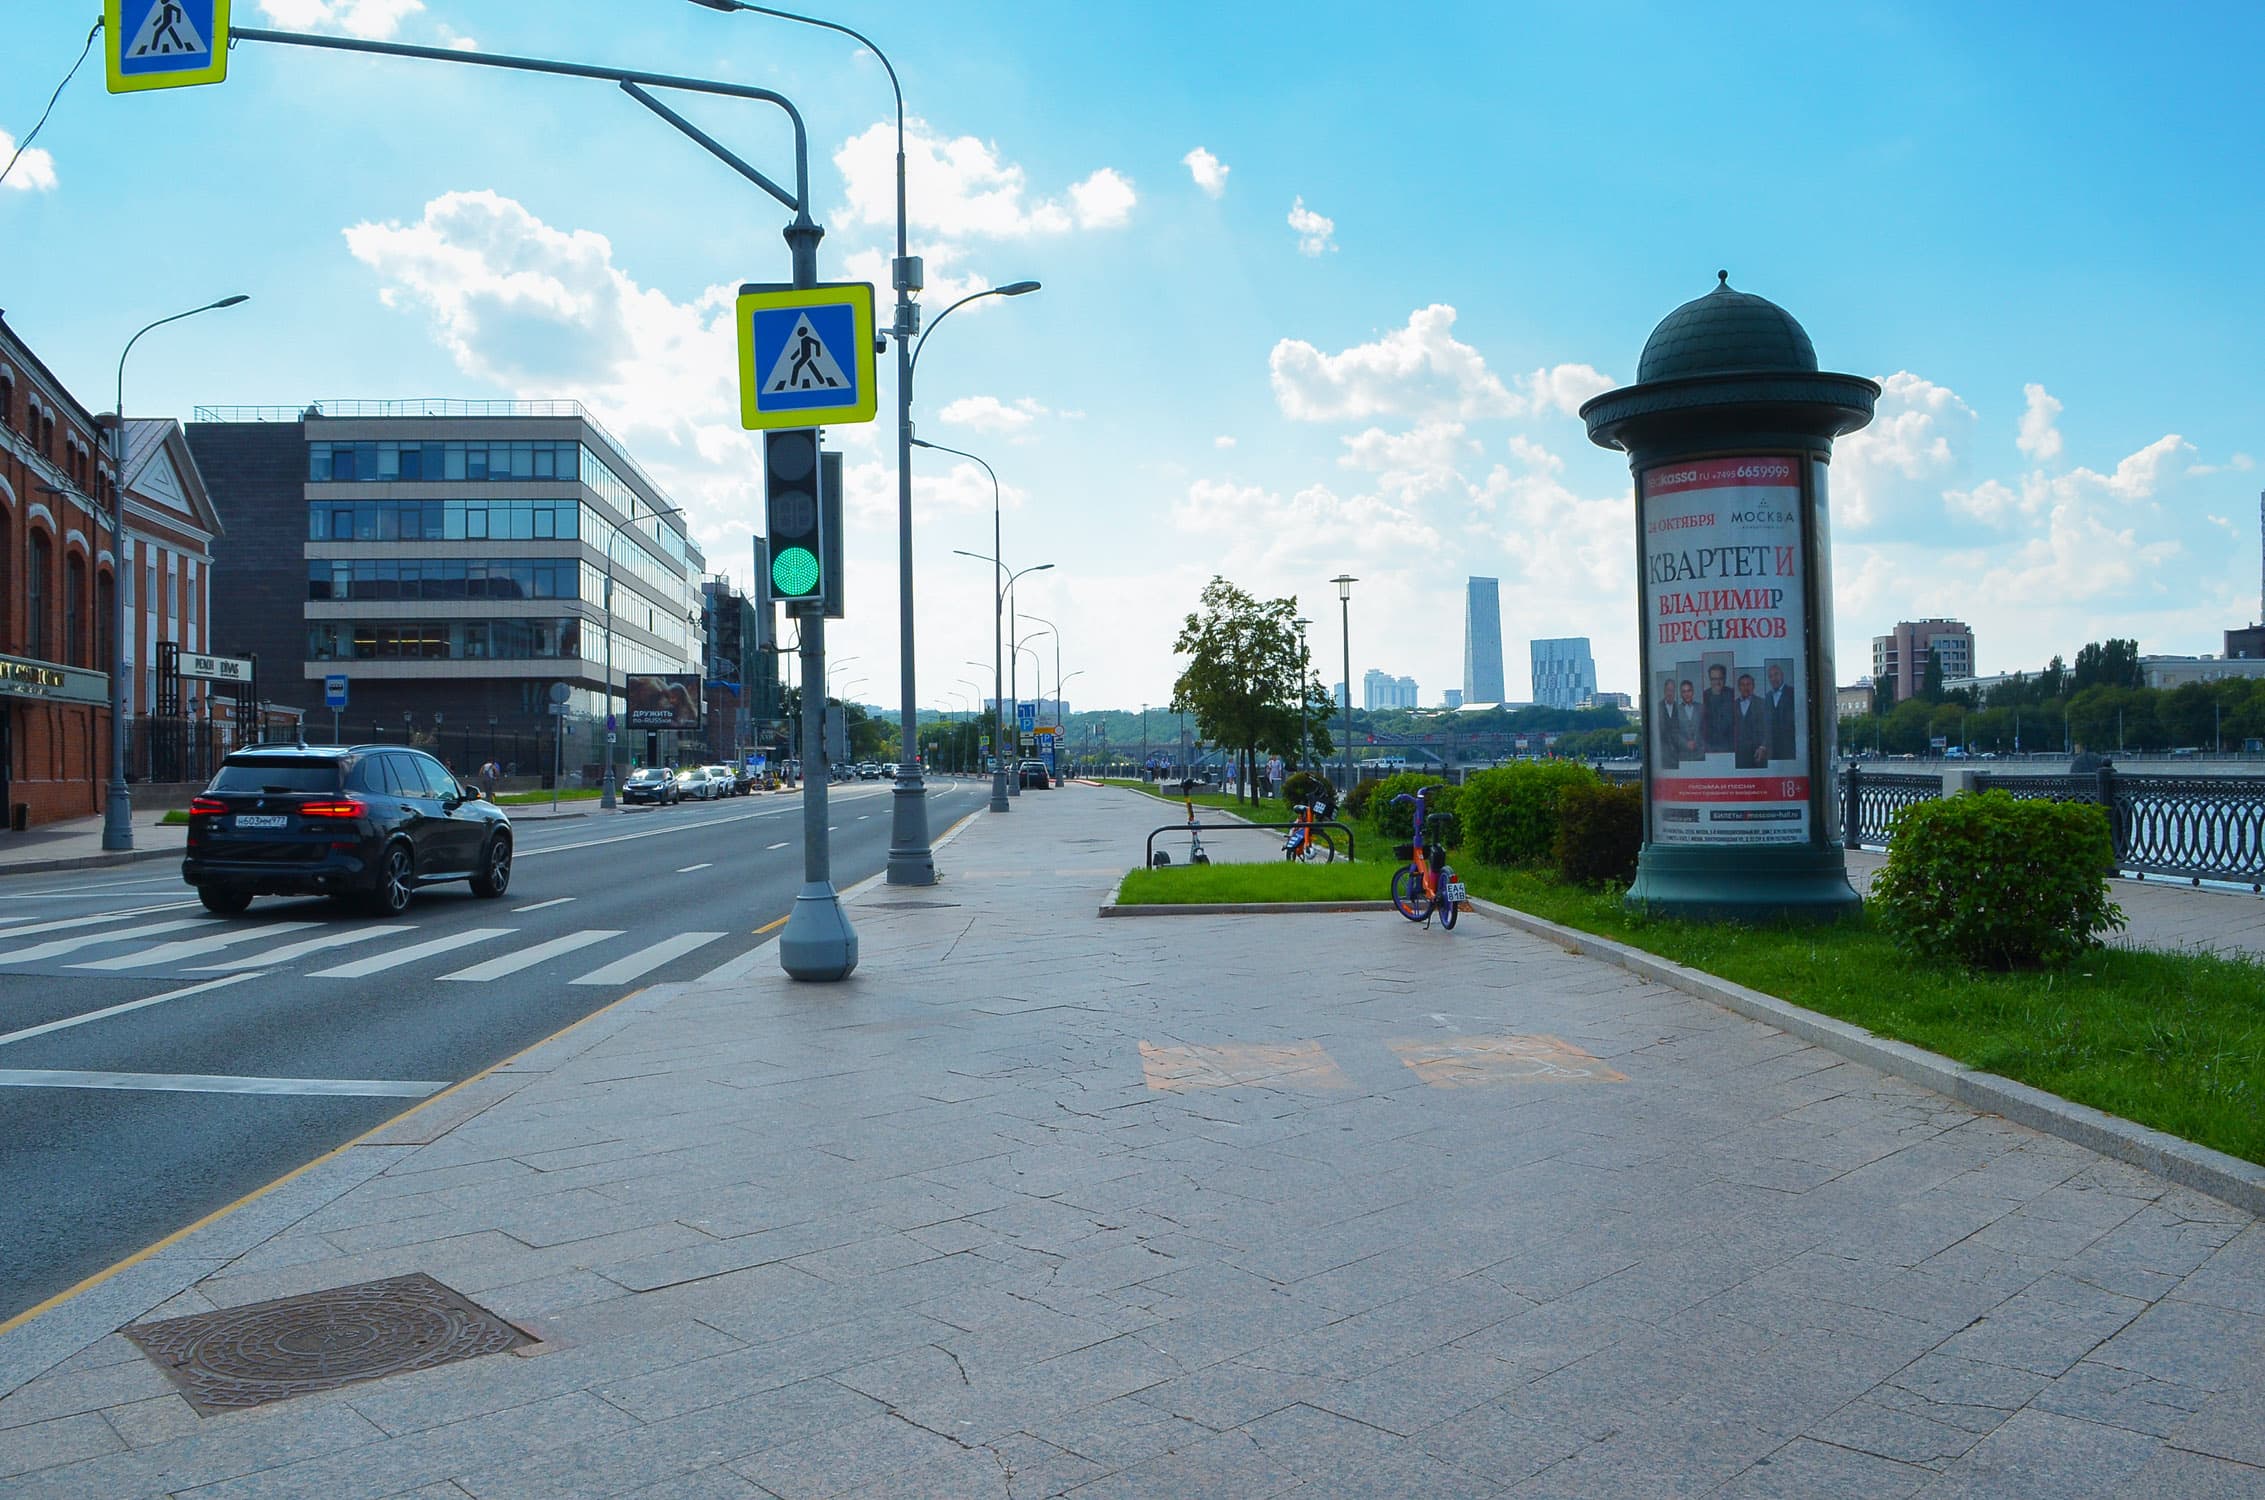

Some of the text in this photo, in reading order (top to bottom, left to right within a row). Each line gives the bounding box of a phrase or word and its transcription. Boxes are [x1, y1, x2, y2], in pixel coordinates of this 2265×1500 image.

[1737, 465, 1790, 478] 6659999
[1658, 513, 1716, 532] ОКТЯБРЯ
[1731, 511, 1795, 523] МОСКВА
[1650, 545, 1795, 585] КВАРТЕТ И
[1659, 588, 1783, 618] ВЛАДИМИР
[1658, 617, 1788, 645] ПРЕСНЯКОВ
[632, 710, 673, 718] ДРУЖИТЬ
